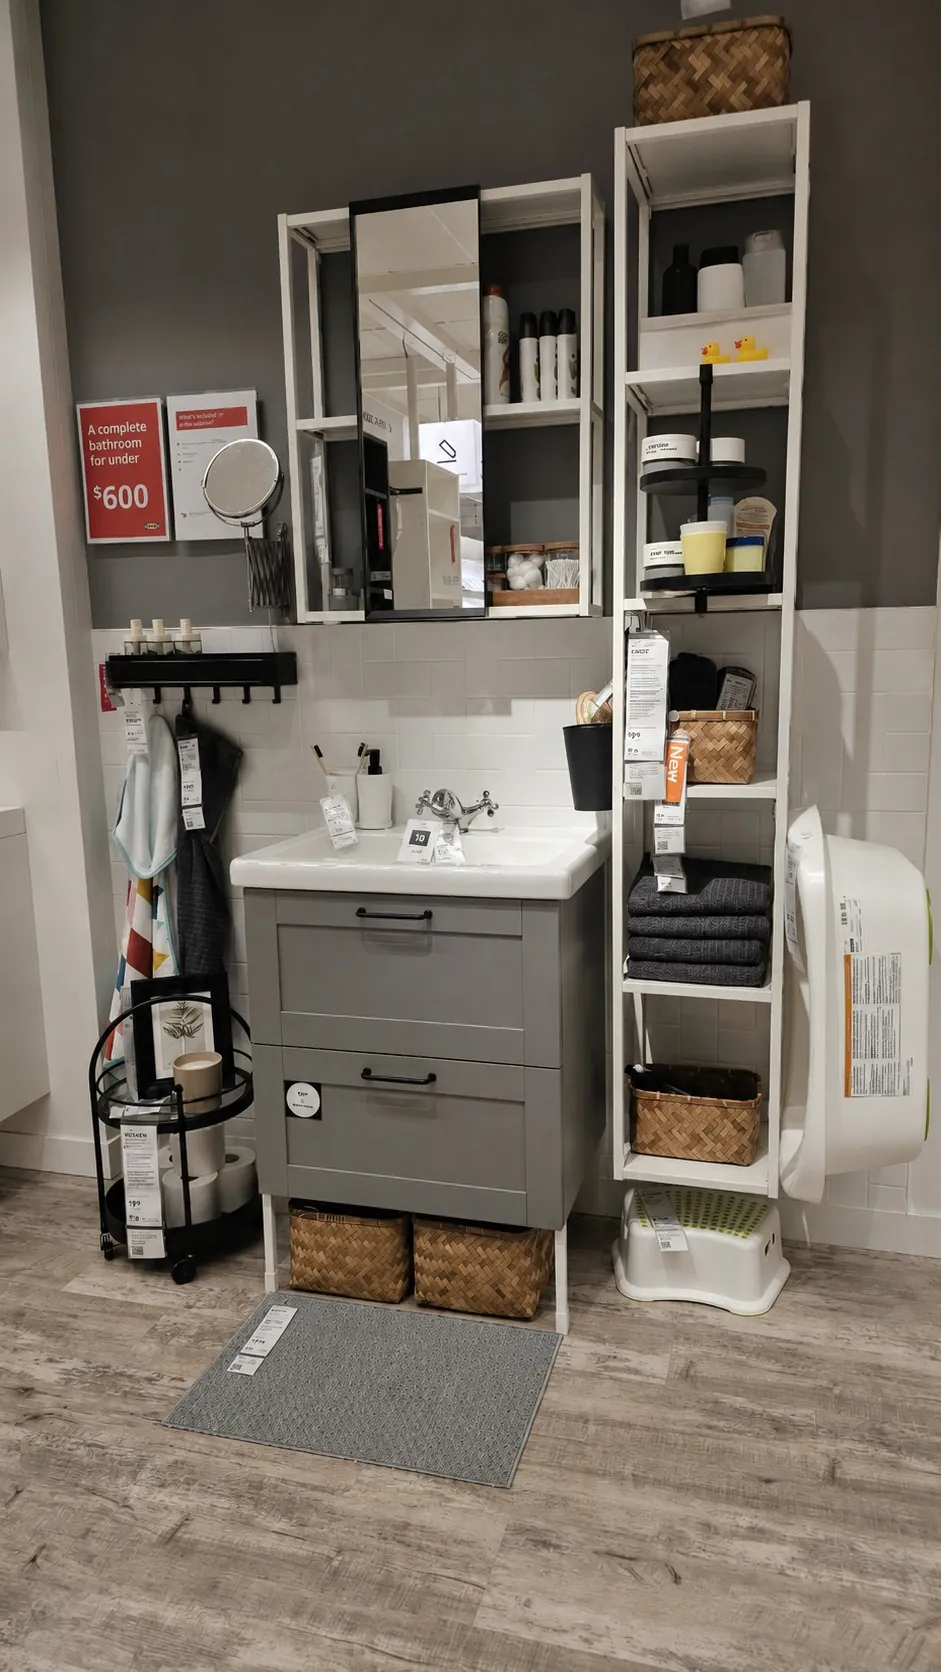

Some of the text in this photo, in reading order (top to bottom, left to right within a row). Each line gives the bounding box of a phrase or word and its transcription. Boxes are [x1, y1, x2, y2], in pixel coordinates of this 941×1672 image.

[88, 421, 147, 436] A complete
[89, 438, 142, 451] bathroom
[90, 453, 140, 466] for under
[93, 484, 149, 510] $600
[668, 745, 685, 783] New
